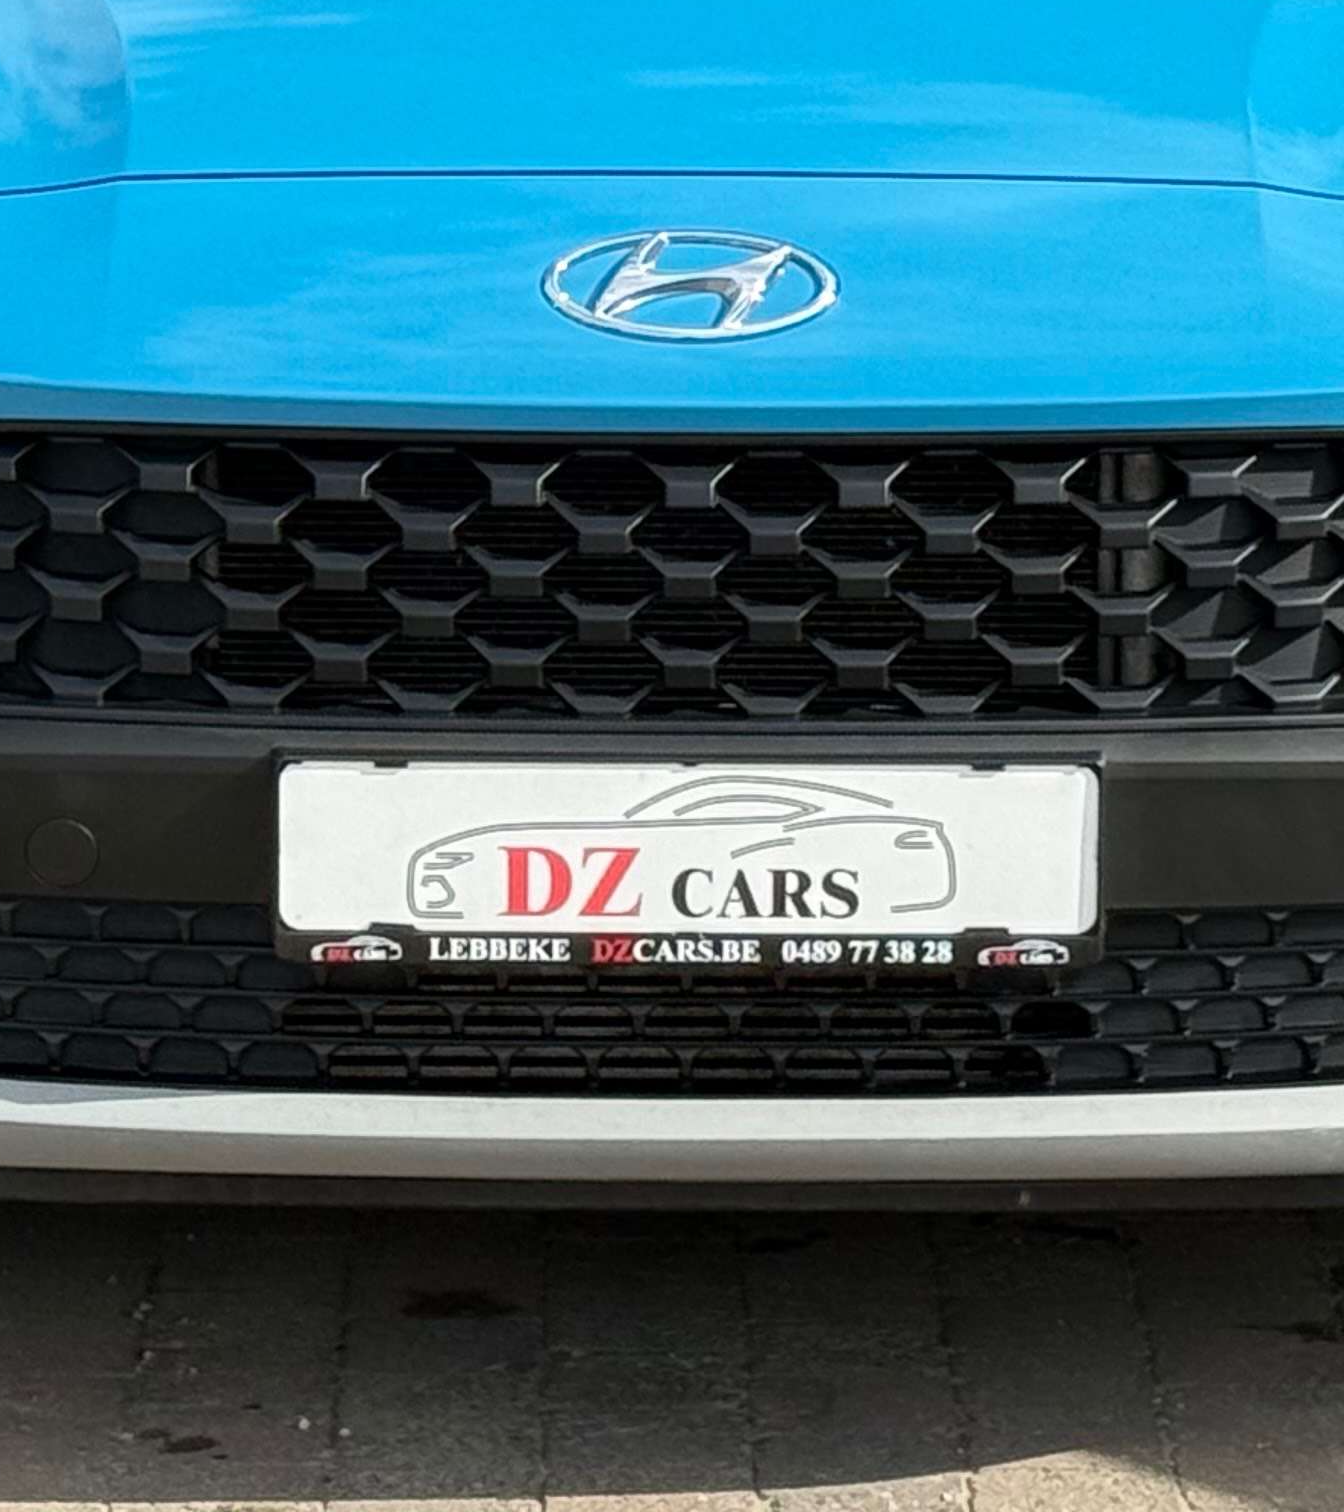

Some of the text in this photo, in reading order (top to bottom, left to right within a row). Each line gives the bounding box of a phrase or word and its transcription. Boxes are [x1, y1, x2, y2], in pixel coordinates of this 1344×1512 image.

[500, 845, 861, 920] DZ CARS
[429, 938, 954, 964] LEBBEKE DZCARS.BE 0489 77 38 28
